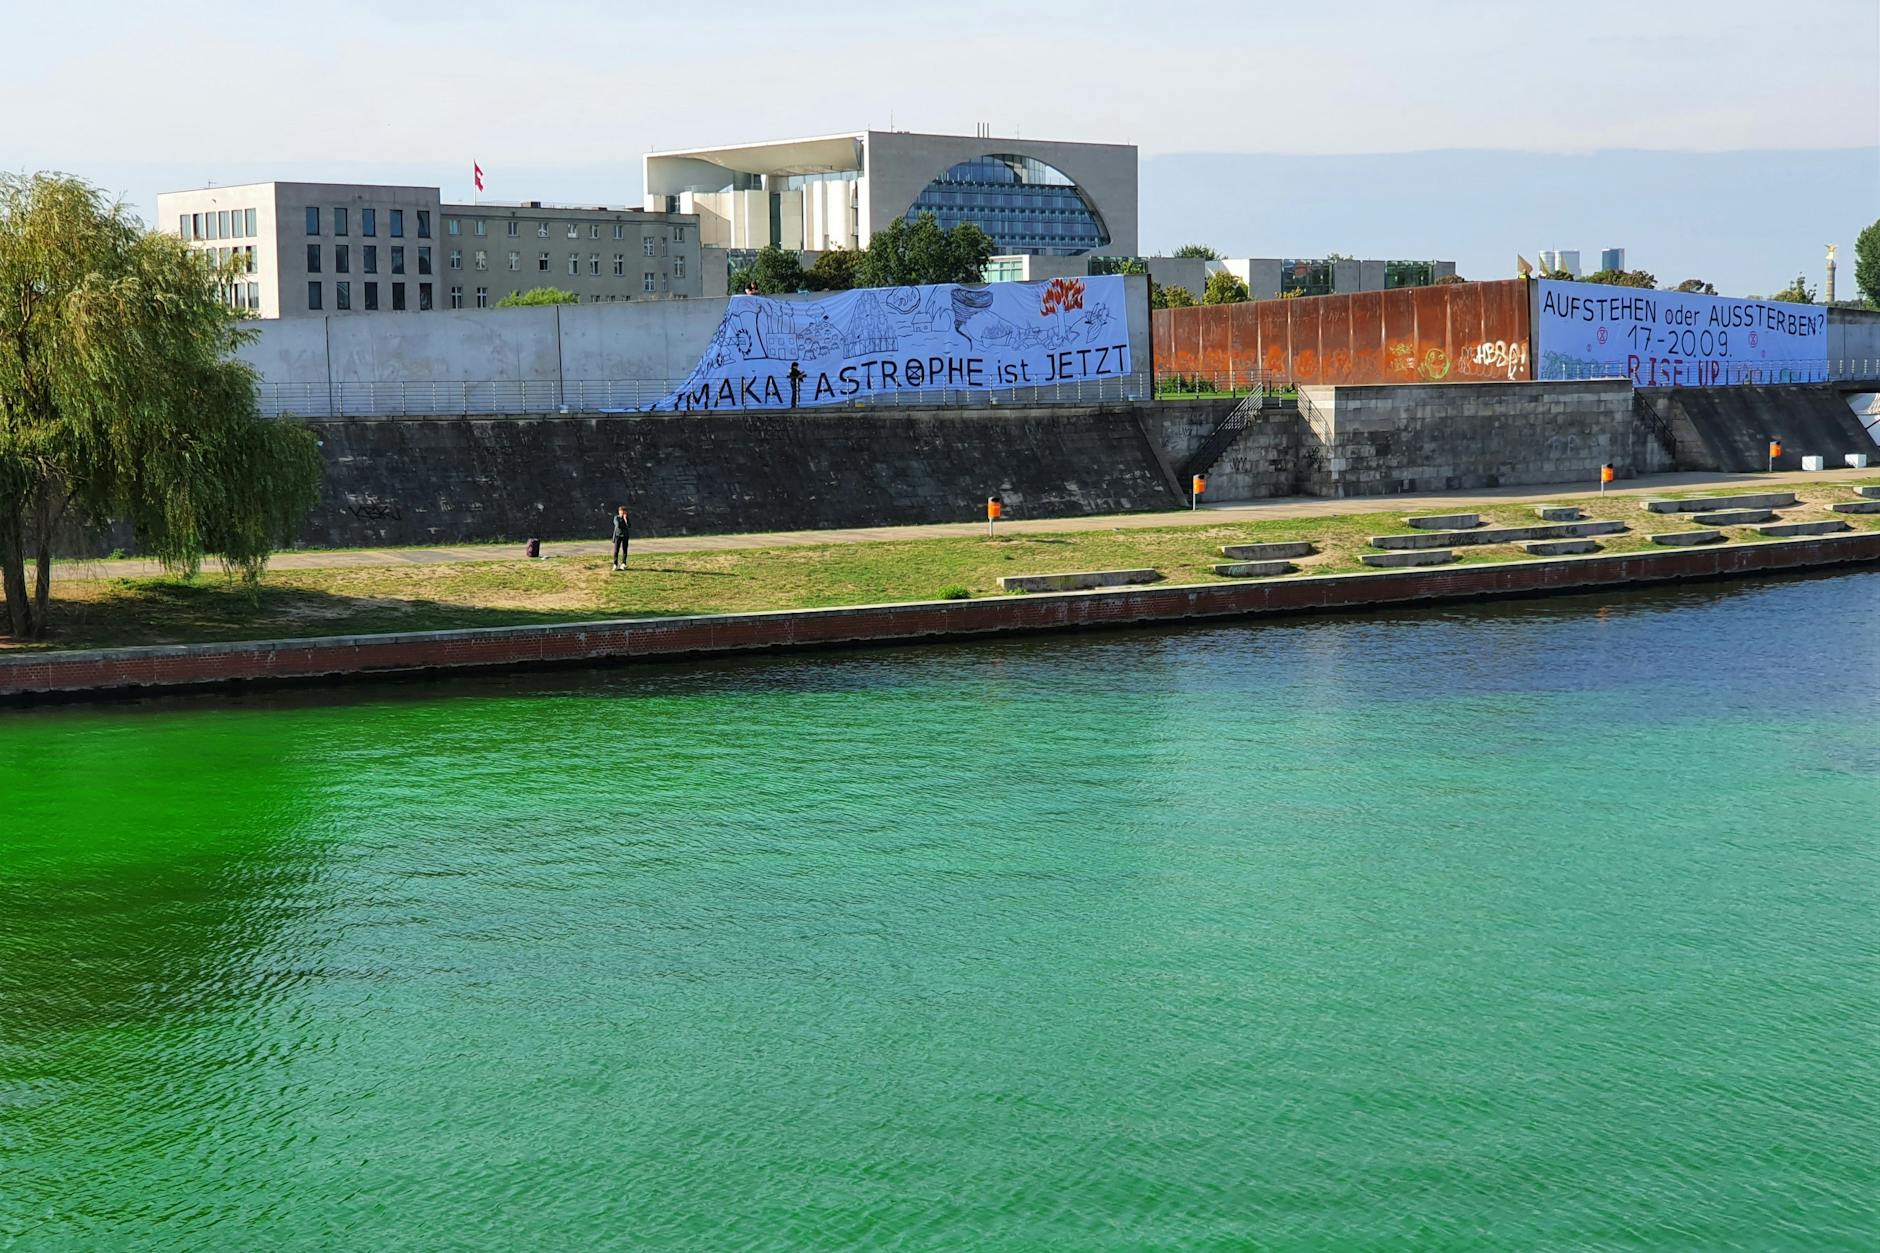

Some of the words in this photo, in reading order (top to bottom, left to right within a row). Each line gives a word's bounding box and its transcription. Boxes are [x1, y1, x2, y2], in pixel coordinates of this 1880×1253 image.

[1543, 290, 1656, 323] AUFSTEHEN
[1665, 304, 1700, 326] oder
[1708, 304, 1825, 337] AUSSTERBEN?
[997, 359, 1031, 384] ist
[1044, 344, 1127, 381] JETZT
[1627, 354, 1683, 387] RISE
[1698, 359, 1720, 386] UP
